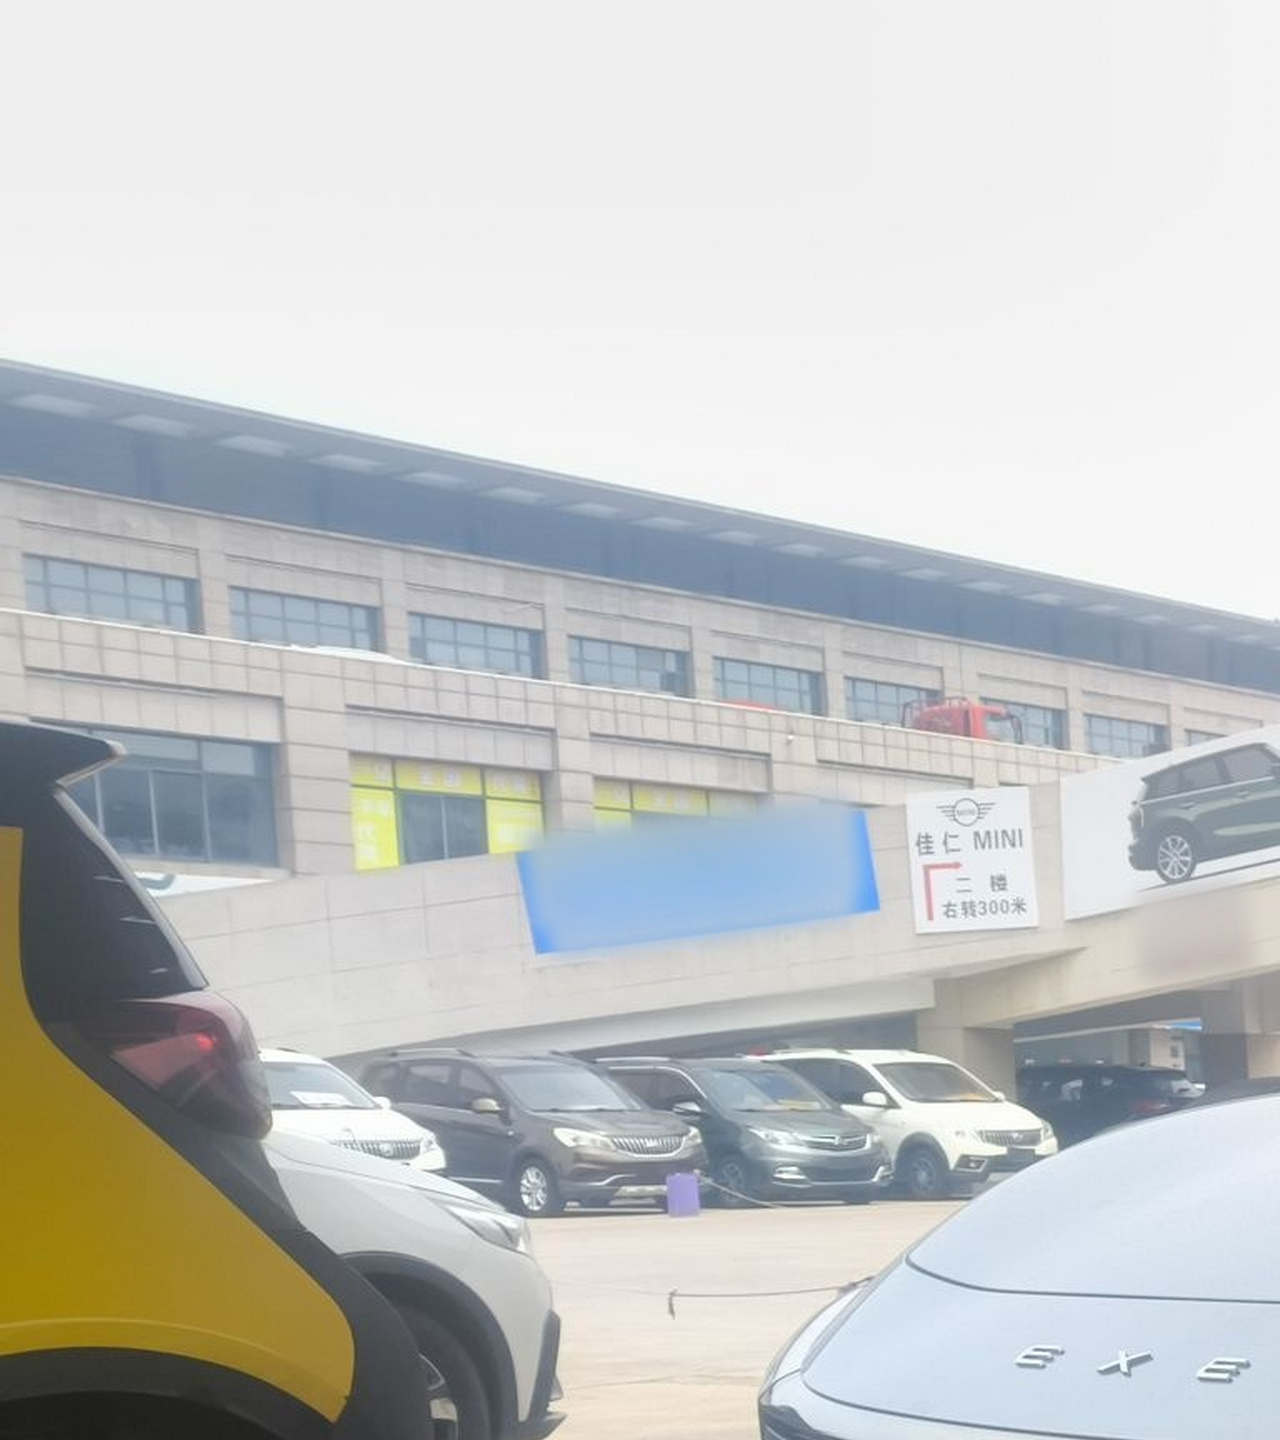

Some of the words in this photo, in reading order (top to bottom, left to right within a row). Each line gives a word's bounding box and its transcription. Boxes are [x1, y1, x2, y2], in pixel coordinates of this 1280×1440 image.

[915, 832, 962, 857] 佳仁
[972, 828, 1024, 851] MINI
[941, 896, 1028, 920] 右转300米
